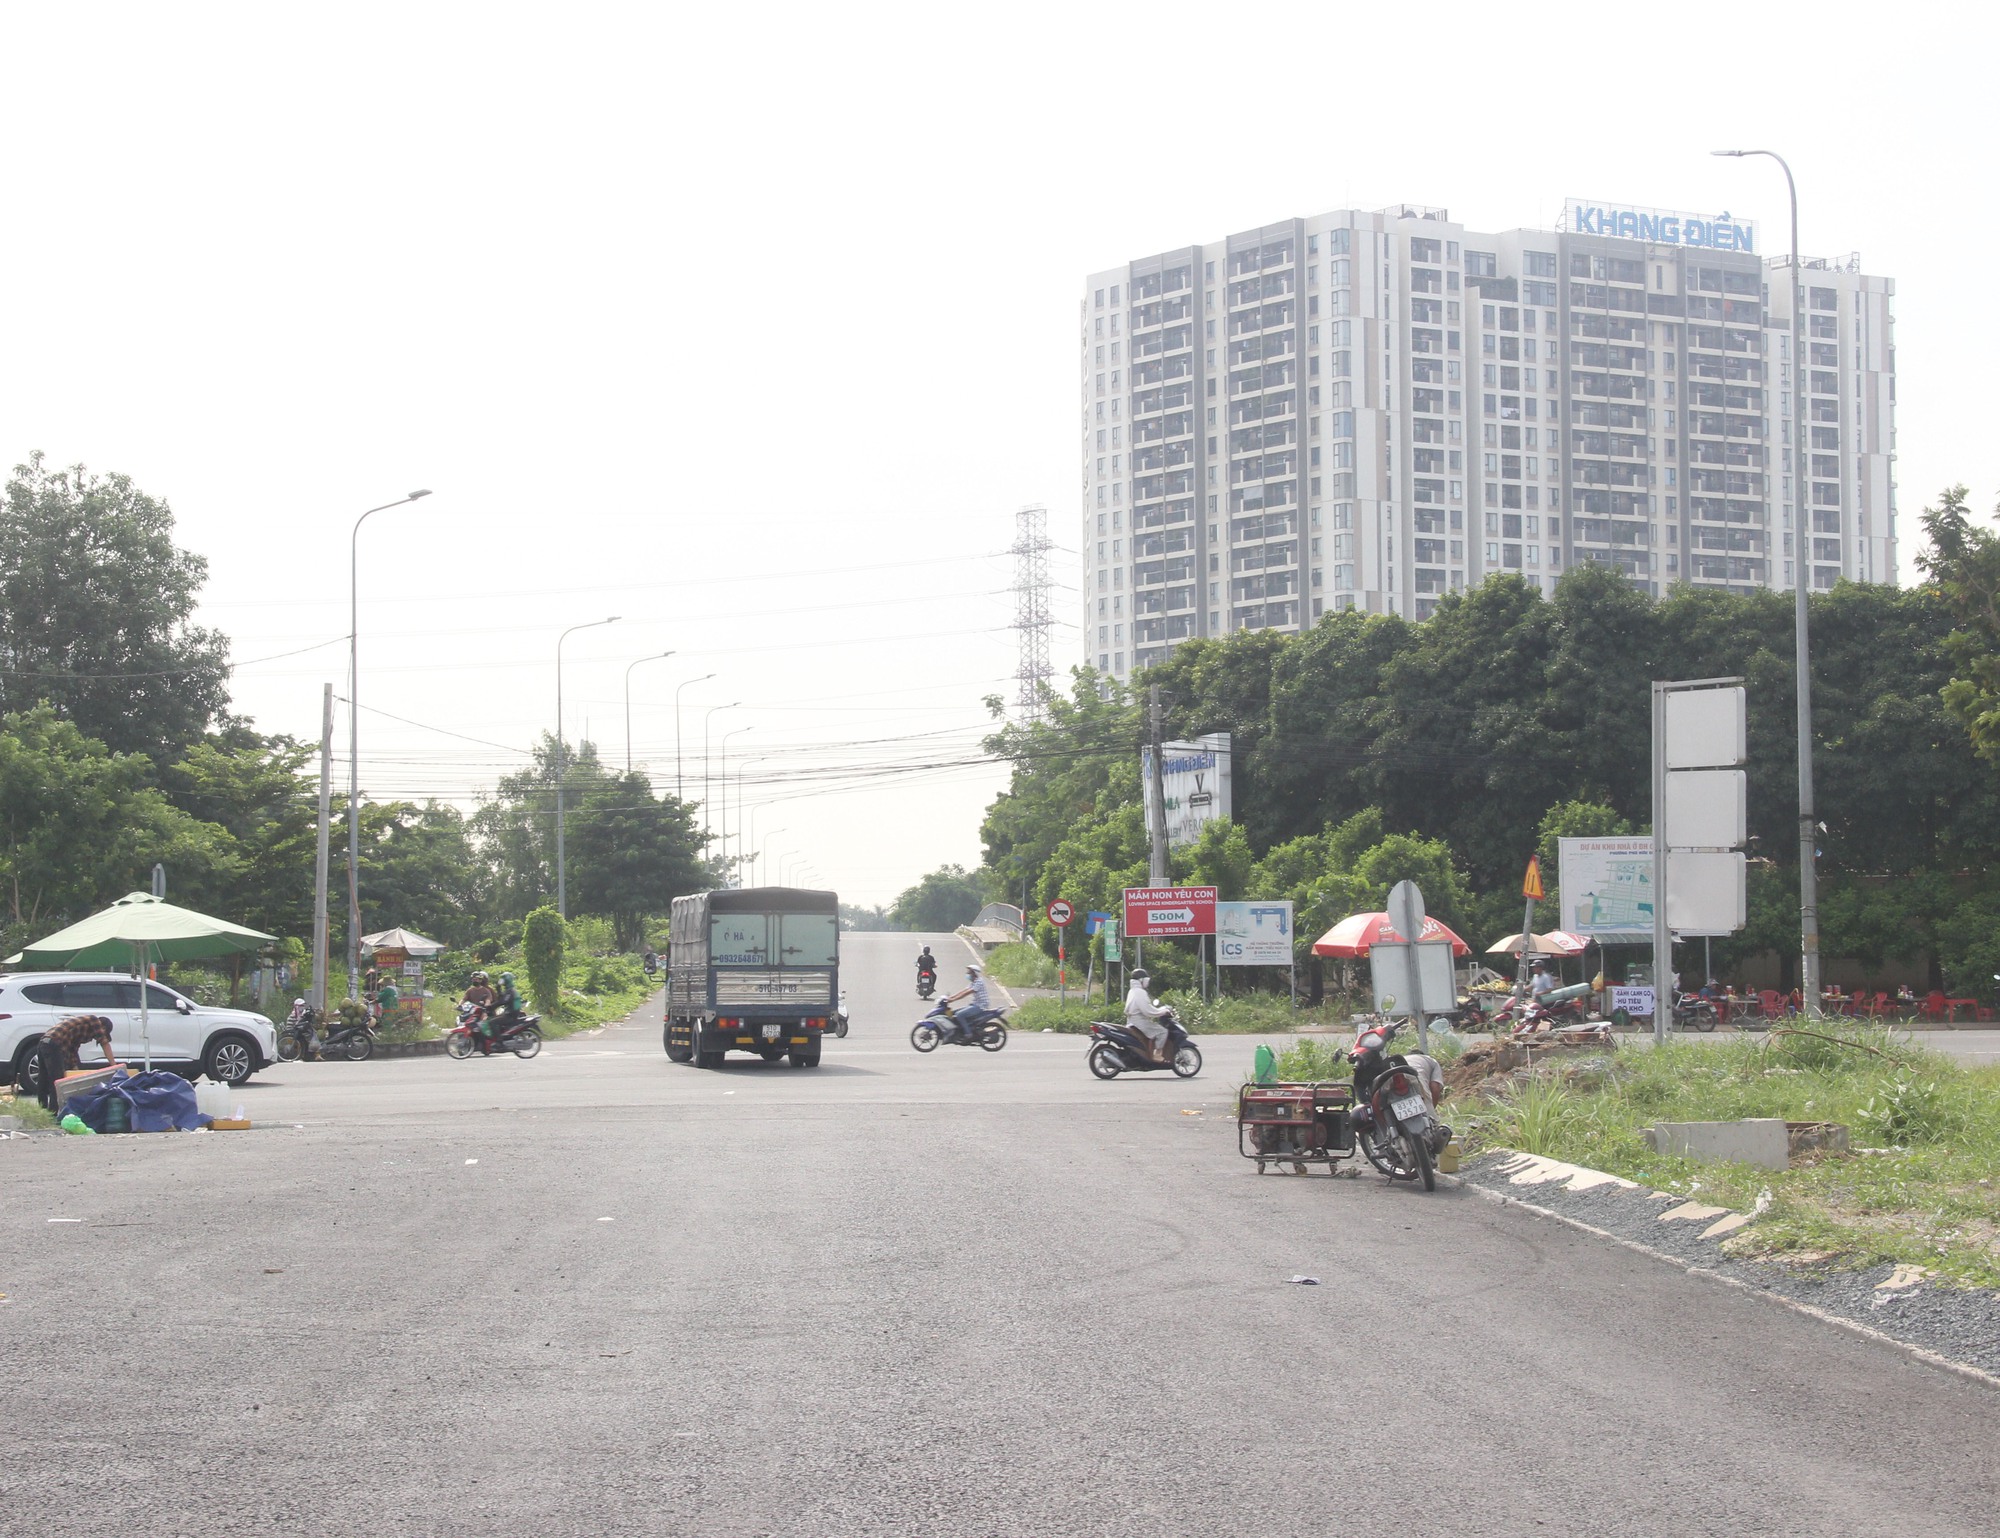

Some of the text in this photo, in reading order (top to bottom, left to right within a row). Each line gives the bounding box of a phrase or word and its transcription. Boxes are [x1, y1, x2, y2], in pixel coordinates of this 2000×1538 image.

[1576, 205, 1753, 253] KHANG ĐIỀN
[1616, 842, 1631, 850] NHÀ
[1152, 891, 1172, 899] NON
[1174, 889, 1192, 899] YÊU
[1194, 890, 1213, 898] CON
[1151, 912, 1184, 921] 500M
